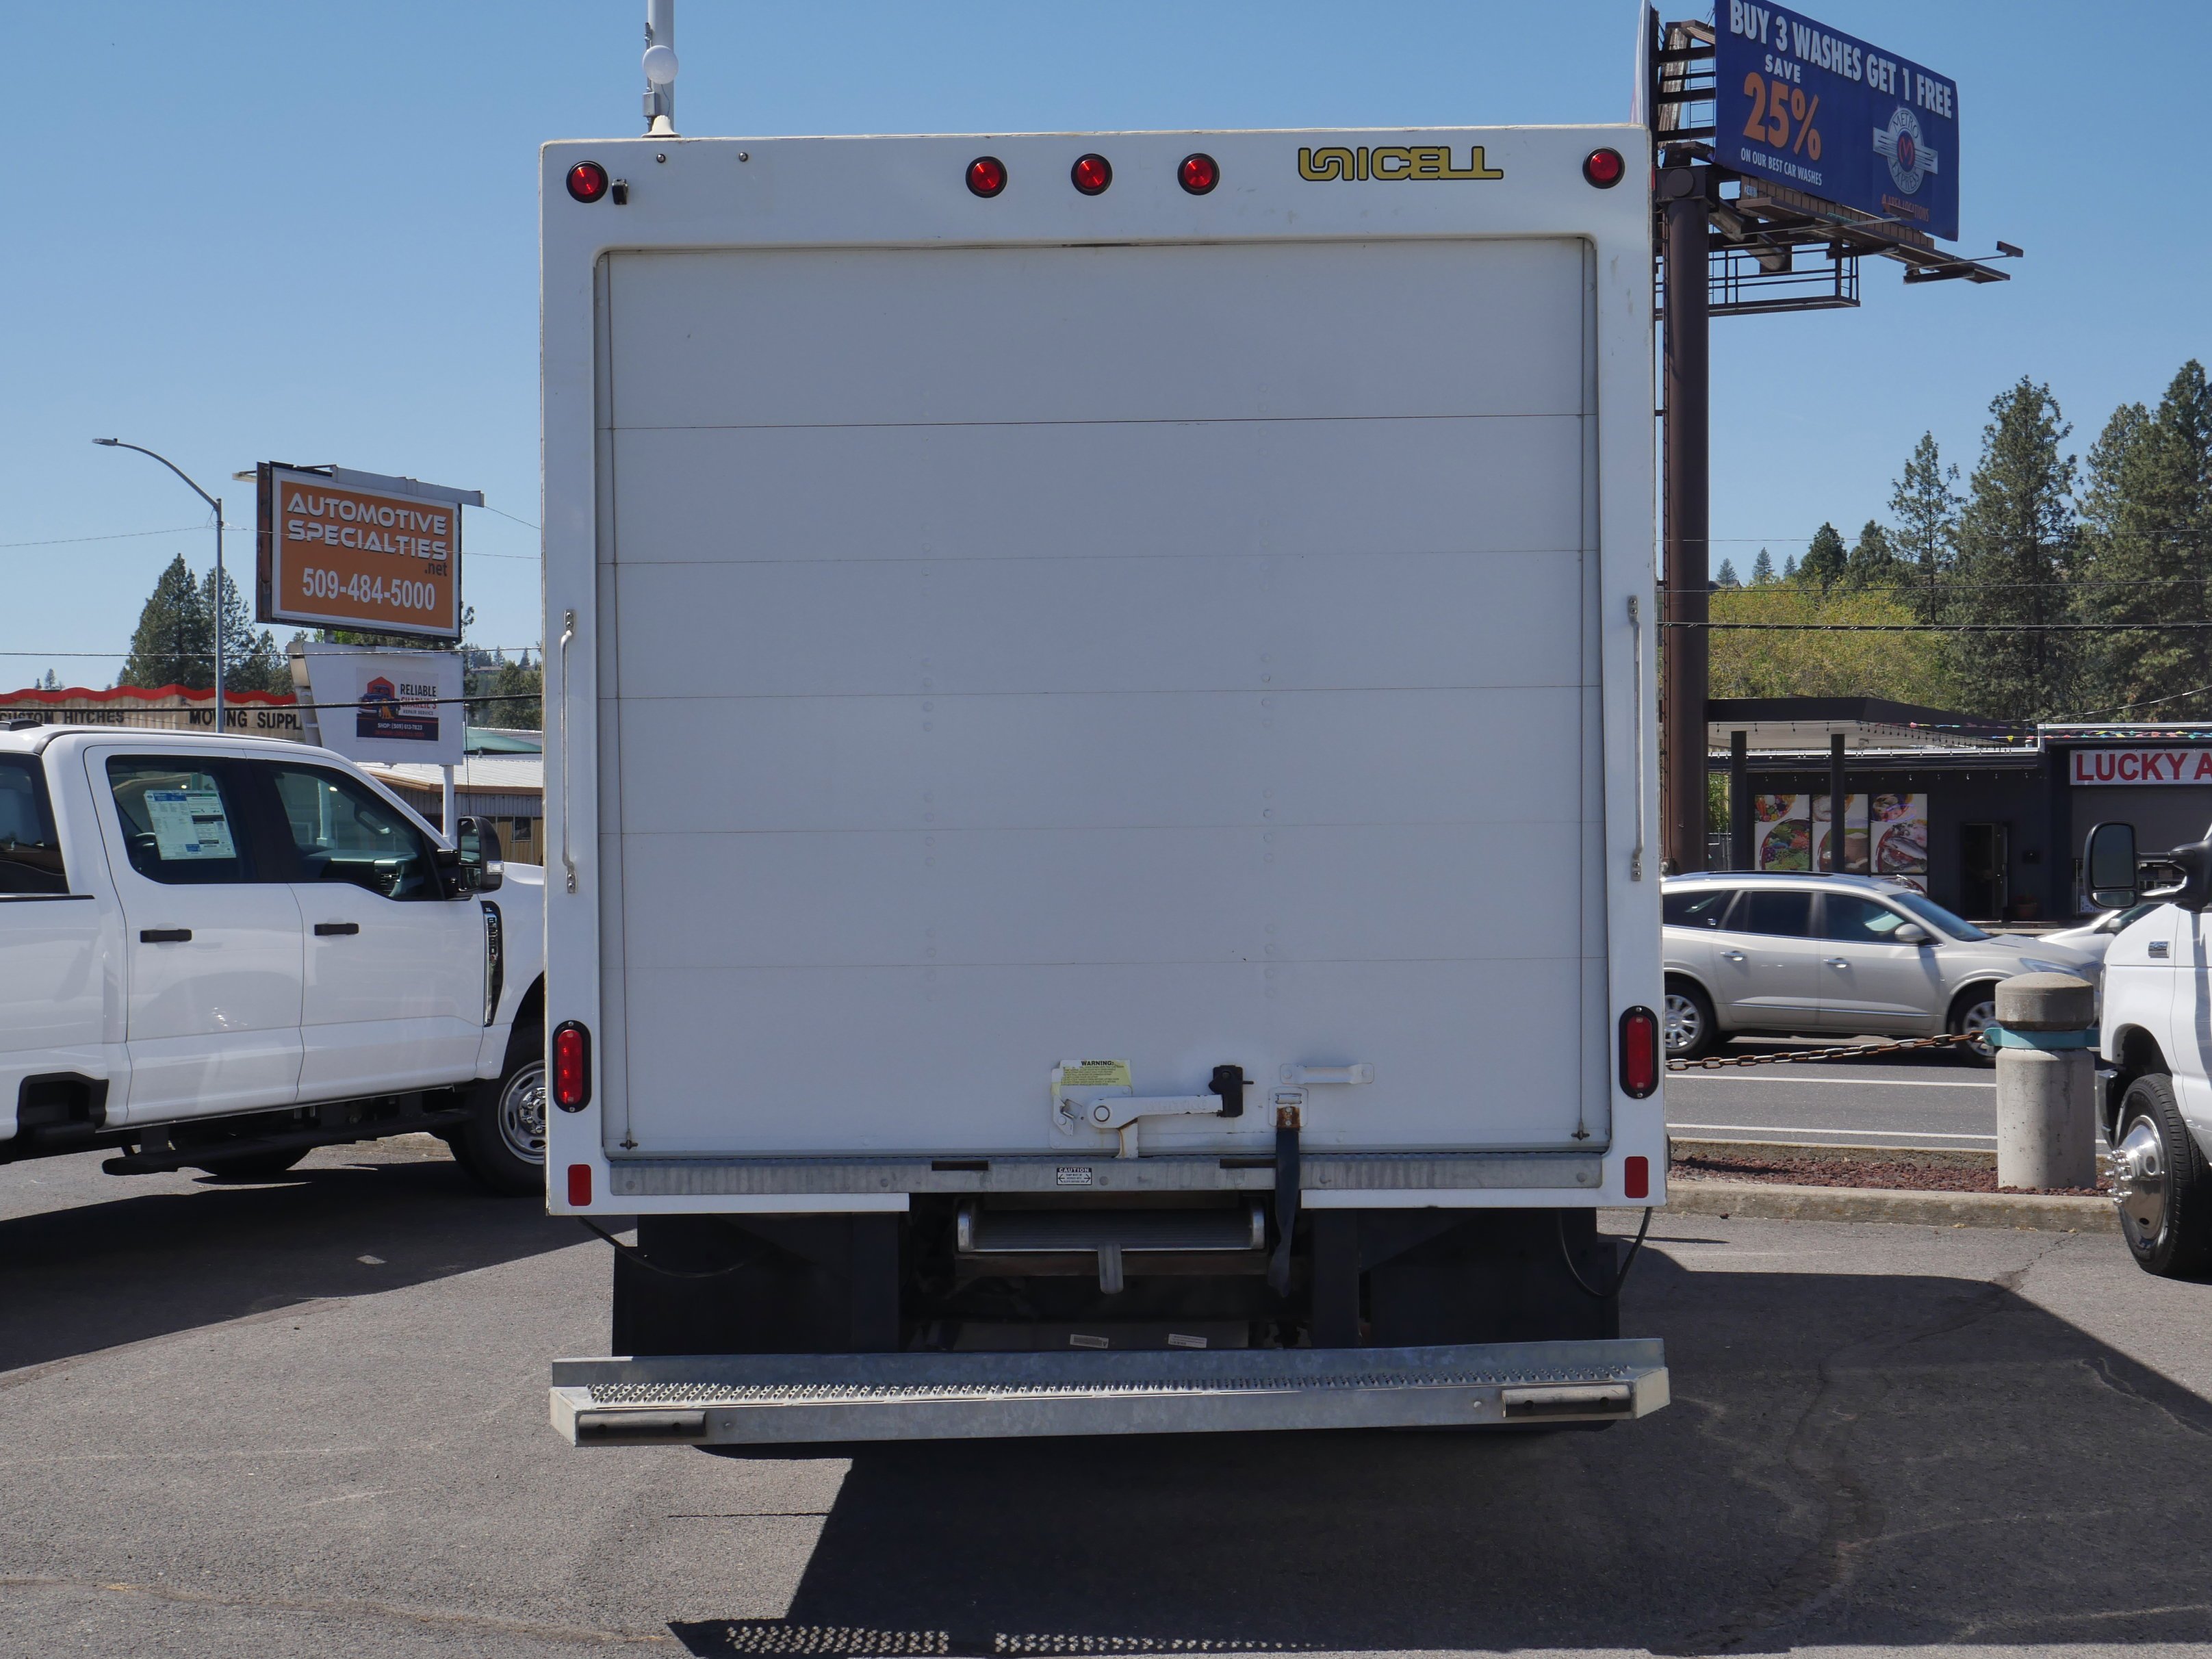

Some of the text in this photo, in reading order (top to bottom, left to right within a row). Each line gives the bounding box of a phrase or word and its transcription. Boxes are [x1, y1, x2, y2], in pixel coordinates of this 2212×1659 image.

[1730, 0, 1952, 118] BUY 3 WASHES GET 1 FREE
[1765, 54, 1801, 83] SAVE
[1743, 72, 1821, 160] 25%
[1892, 112, 1919, 138] METRO
[1298, 146, 1504, 181] UNICELL
[1741, 148, 1823, 186] ON OUR BEST CAR WASHES
[1892, 160, 1919, 190] EXPRESS
[287, 492, 447, 536] AUTOMOTIVE
[287, 519, 448, 561] SPECIALTIES
[424, 562, 447, 577] .net
[302, 567, 435, 610] 509-484-5000
[400, 684, 436, 697] RELIABLE
[401, 696, 437, 709] CHARLIES
[64, 710, 124, 724] HITCHES
[257, 711, 303, 730] SUPPL
[2076, 753, 2188, 781] LUCKY
